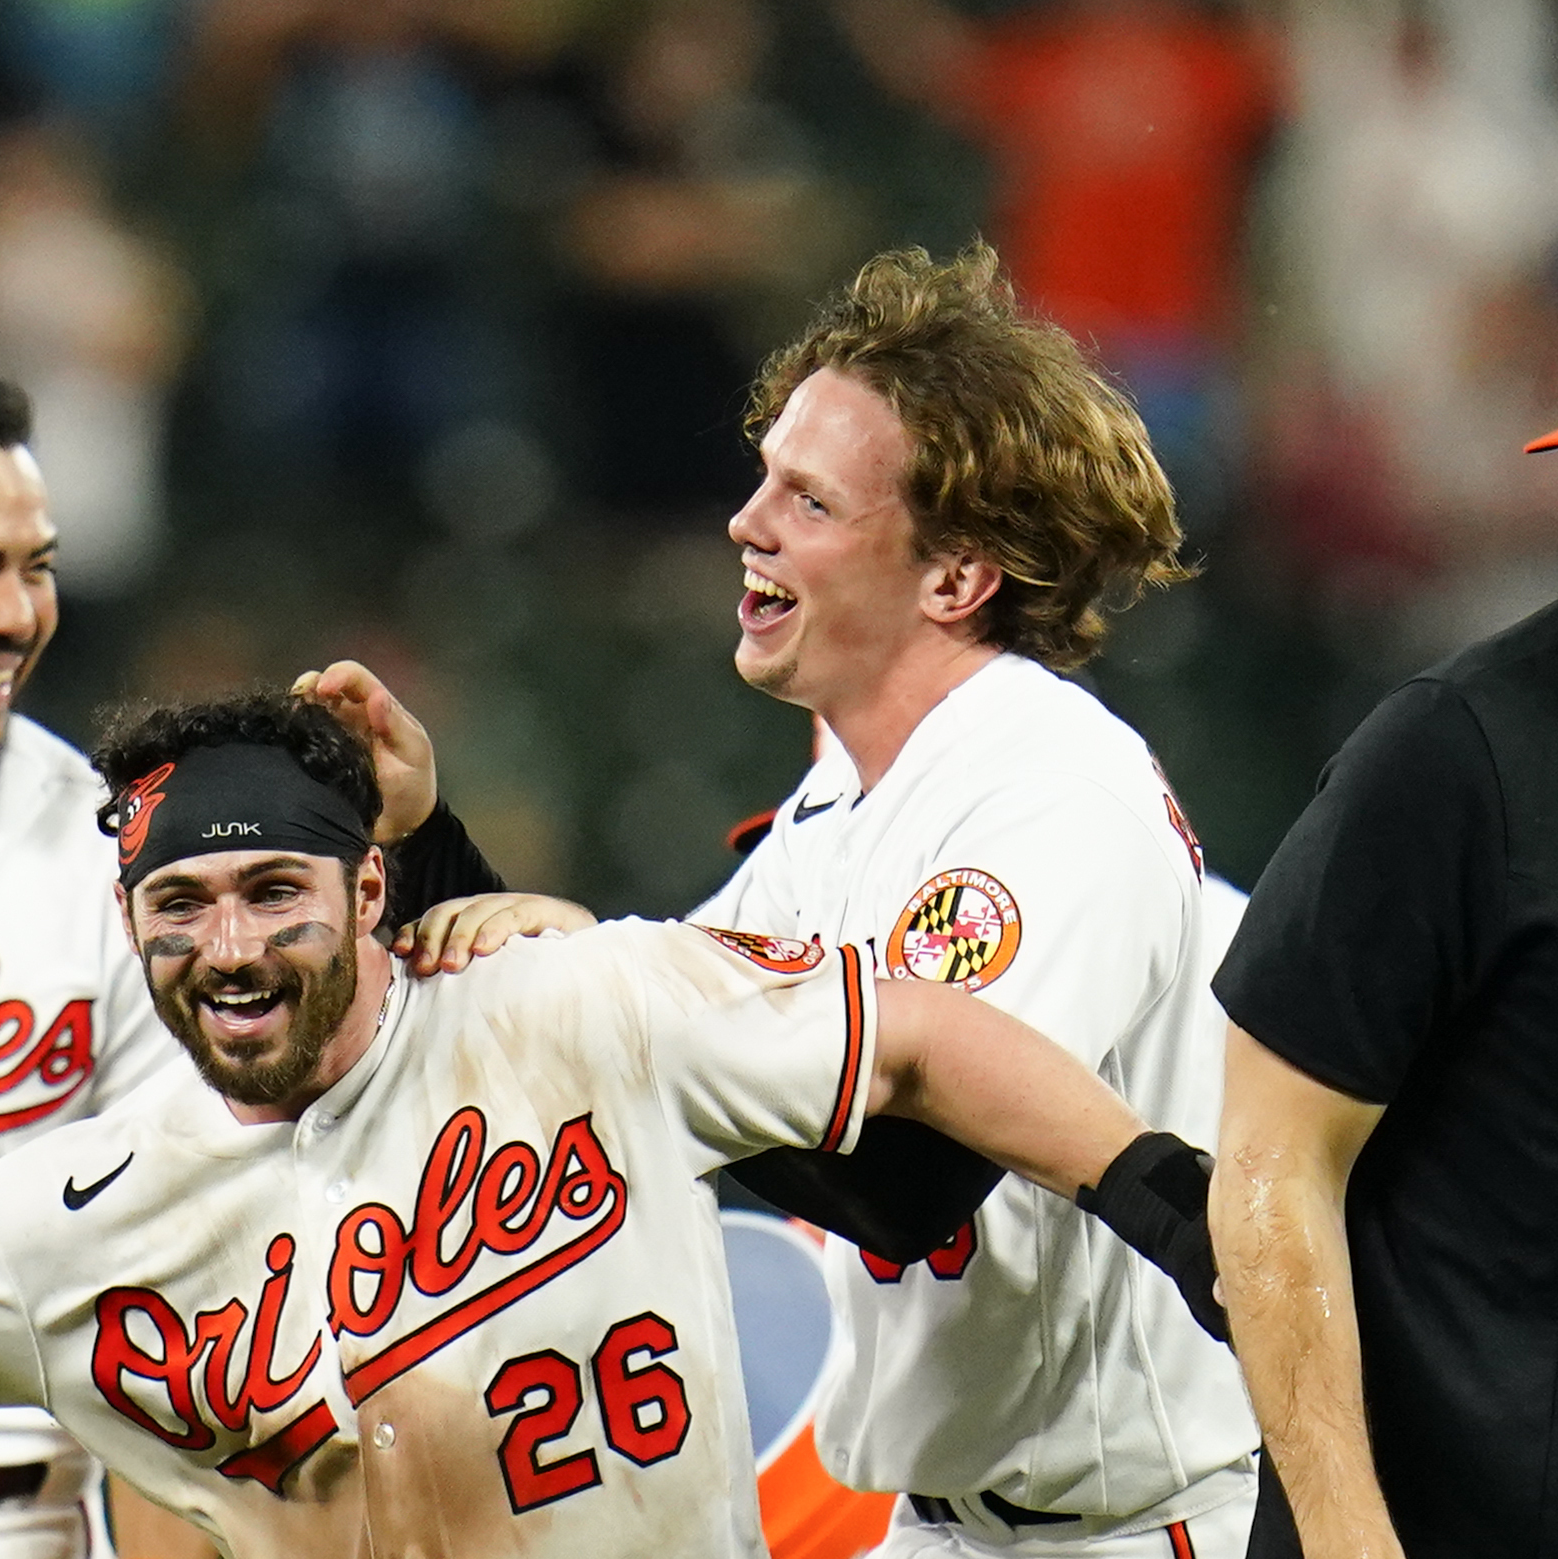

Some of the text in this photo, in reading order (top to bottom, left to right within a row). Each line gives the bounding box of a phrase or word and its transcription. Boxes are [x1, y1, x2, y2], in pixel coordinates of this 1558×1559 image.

[201, 821, 263, 839] JUNK
[906, 869, 1018, 926] BALTIMORE
[90, 1104, 627, 1451] Orioles
[483, 1310, 693, 1515] 26
